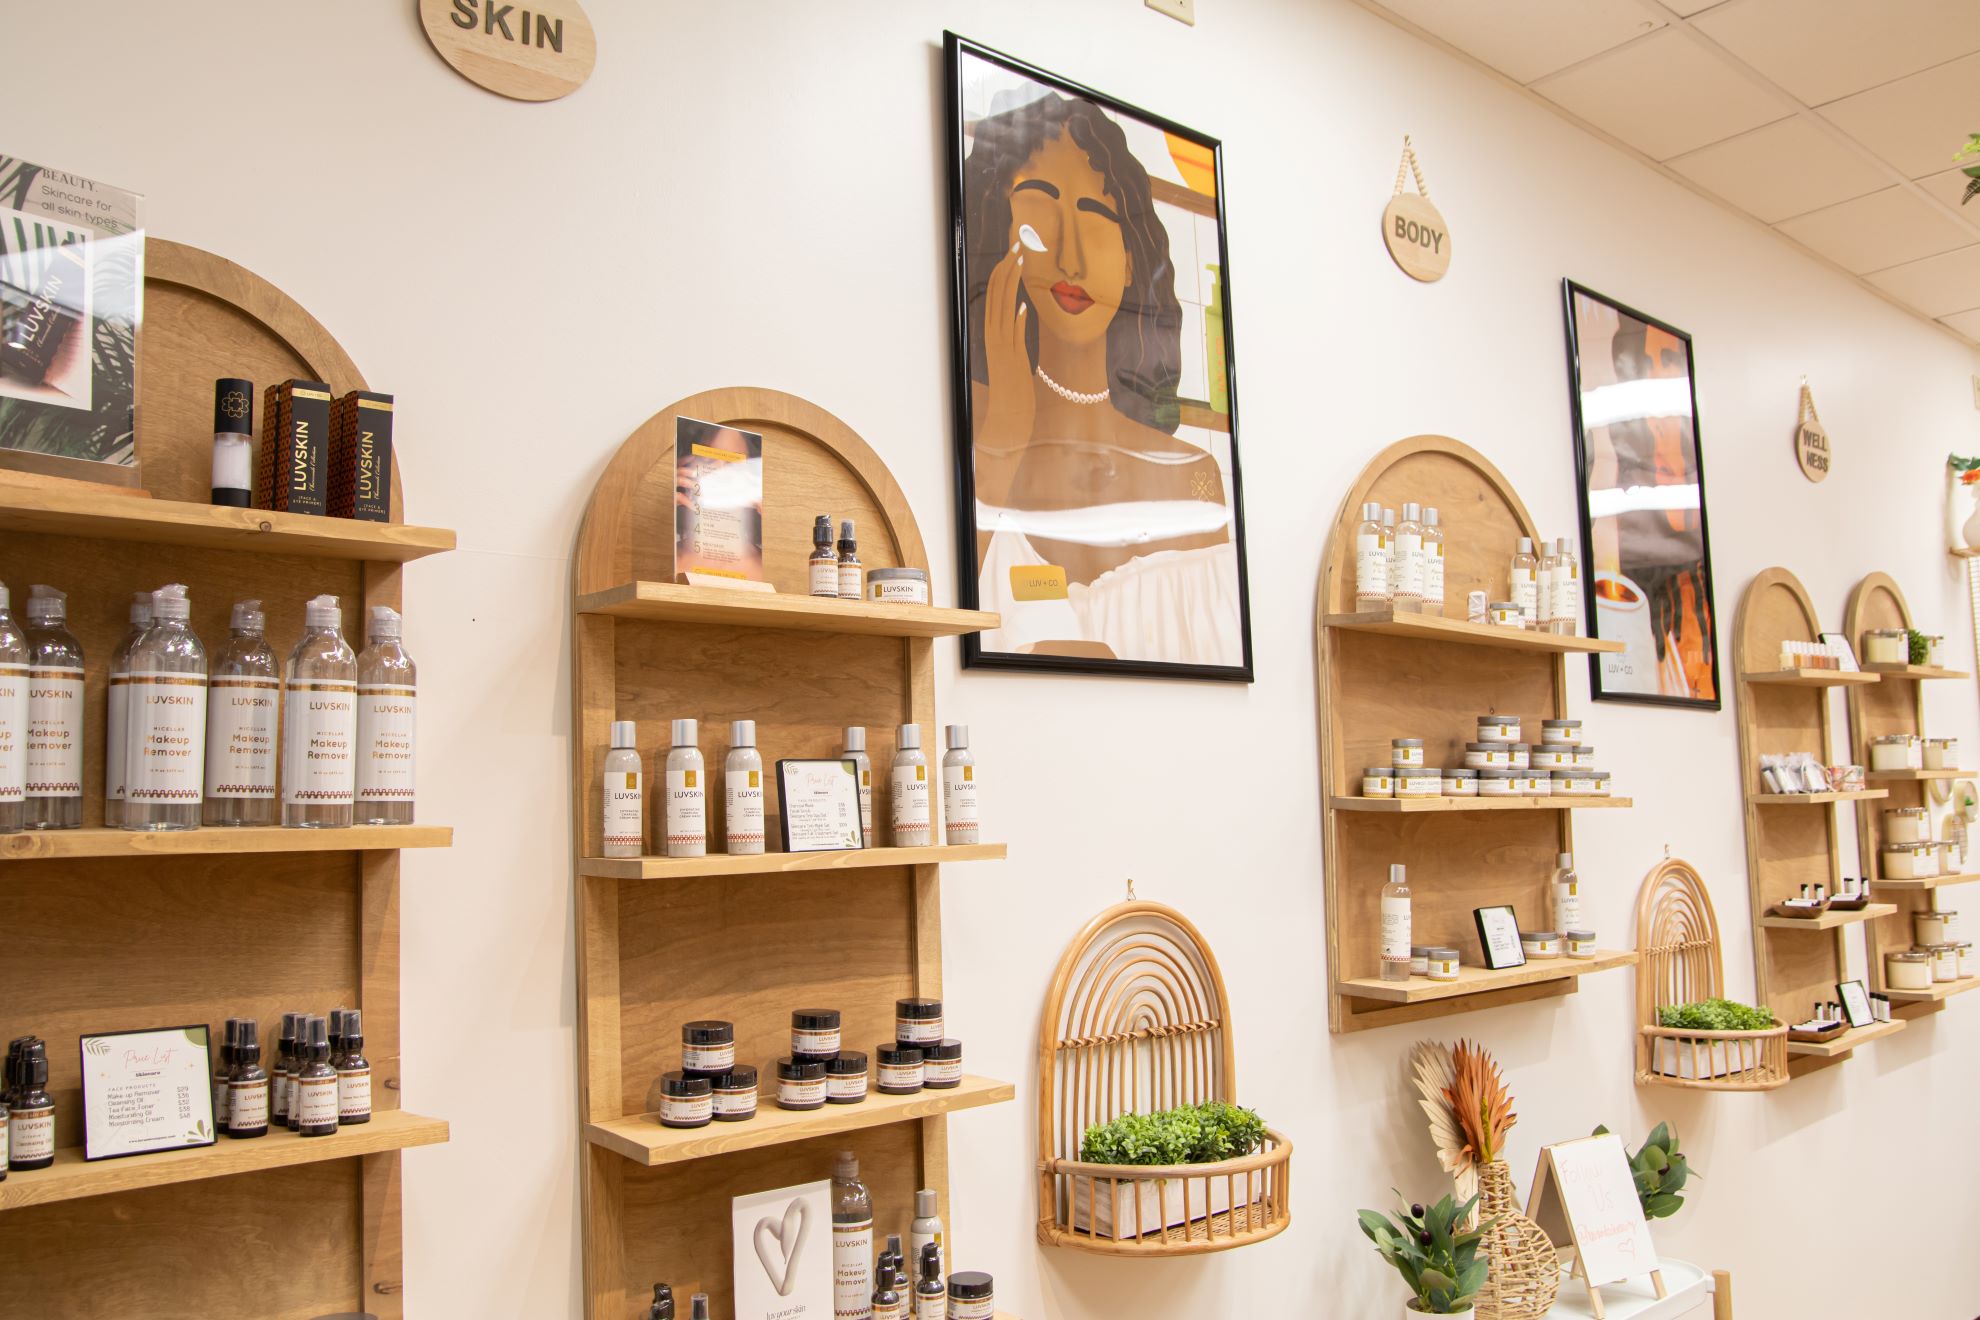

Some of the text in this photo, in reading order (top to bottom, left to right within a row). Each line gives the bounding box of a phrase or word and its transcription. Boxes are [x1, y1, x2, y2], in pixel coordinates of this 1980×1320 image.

[451, 0, 563, 53] SKIN
[42, 168, 98, 193] BEAUTY.
[41, 185, 112, 212] Skincare for
[41, 201, 118, 229] all skin types
[1395, 215, 1443, 254] BODY
[20, 275, 63, 342] LUVSKIN
[1803, 428, 1828, 452] WELL
[294, 421, 309, 491] LUVSKIN
[360, 431, 374, 499] LUVSKIN
[1806, 450, 1828, 473] NESS
[694, 483, 700, 497] 2
[694, 503, 700, 516] 3
[694, 541, 700, 554] 5
[883, 584, 913, 593] LUVSKIN
[1029, 579, 1041, 588] LUV
[1048, 579, 1058, 587] CO
[1608, 663, 1619, 673] LUV
[29, 689, 73, 699] UVSKIN
[147, 695, 194, 705] LUVSKIN
[232, 697, 273, 707] LUVSKIN
[309, 701, 350, 711] LUVSKIN
[374, 704, 412, 714] LUVSKIN
[147, 735, 190, 746] Makeup
[232, 734, 270, 744] Makeup
[310, 739, 348, 749] Makeup
[375, 740, 410, 749] Makeup
[144, 748, 192, 757] Remover
[229, 746, 271, 755] Remover
[307, 751, 349, 760] Remover
[372, 751, 411, 760] Remover
[124, 1048, 178, 1070] Price List
[134, 1089, 160, 1097] Remover
[108, 1099, 135, 1107] Cleansing
[17, 1120, 52, 1131] LUVSKIN
[835, 1239, 868, 1248] LUVSKIN
[837, 1269, 867, 1279] Makeup
[835, 1278, 868, 1287] Remover
